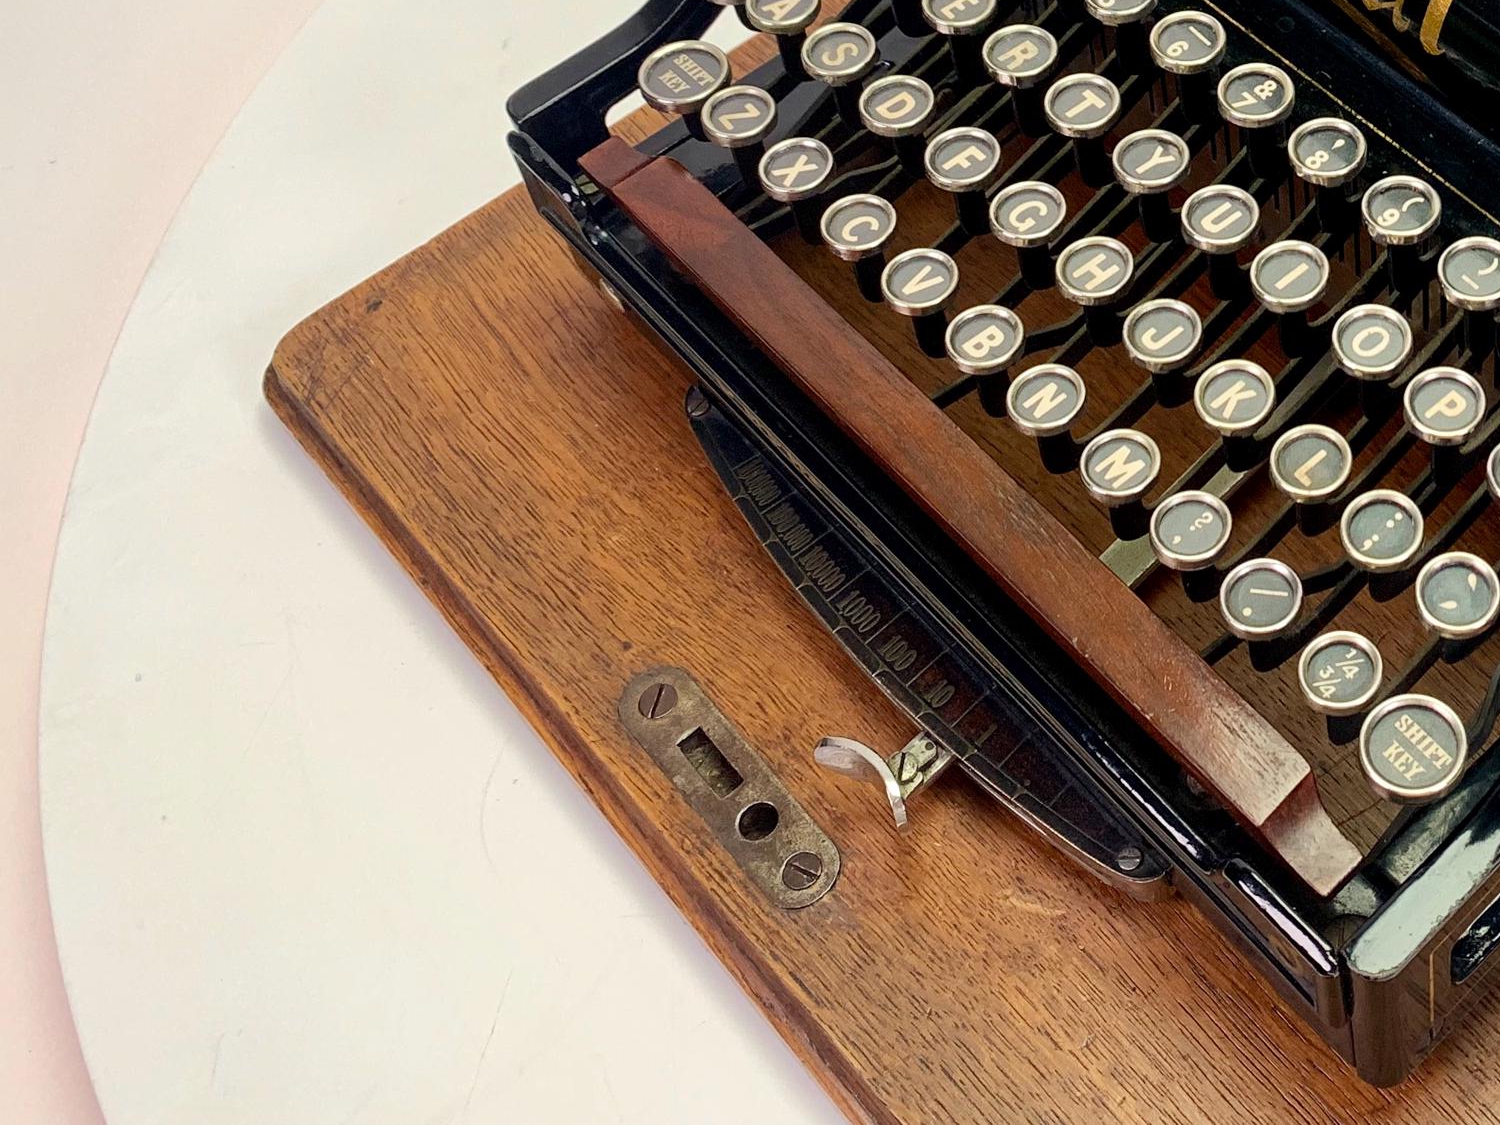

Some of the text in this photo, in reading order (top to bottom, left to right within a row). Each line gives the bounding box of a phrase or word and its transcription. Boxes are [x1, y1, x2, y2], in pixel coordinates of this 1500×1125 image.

[821, 42, 859, 66] S
[997, 39, 1039, 69] R
[1166, 40, 1189, 57] 6
[657, 68, 692, 94] KEY
[673, 54, 716, 87] SHIFT
[875, 91, 916, 119] D
[1065, 89, 1106, 119] T
[1231, 91, 1258, 109] 7
[1253, 80, 1278, 100] &
[718, 103, 761, 130] Z
[771, 155, 818, 186] X
[942, 145, 987, 170] F
[1135, 145, 1176, 175] Y
[1305, 150, 1330, 169] 8
[841, 216, 880, 242] C
[1008, 200, 1048, 232] G
[1201, 201, 1242, 233] U
[1377, 208, 1400, 226] 9
[902, 265, 945, 295] V
[1071, 253, 1120, 291] H
[1274, 262, 1310, 290] I
[962, 325, 1005, 358] B
[1141, 326, 1184, 351] J
[1352, 326, 1391, 357] O
[1022, 382, 1067, 420] N
[1209, 380, 1257, 420] K
[1424, 389, 1467, 419] P
[1094, 445, 1146, 489] M
[1293, 449, 1327, 487] L
[835, 590, 880, 633] 1,000
[878, 635, 917, 671] 100
[924, 679, 956, 707] 10
[975, 724, 998, 748] 1
[1394, 714, 1453, 770] SHIFT
[1382, 739, 1427, 781] KEY
